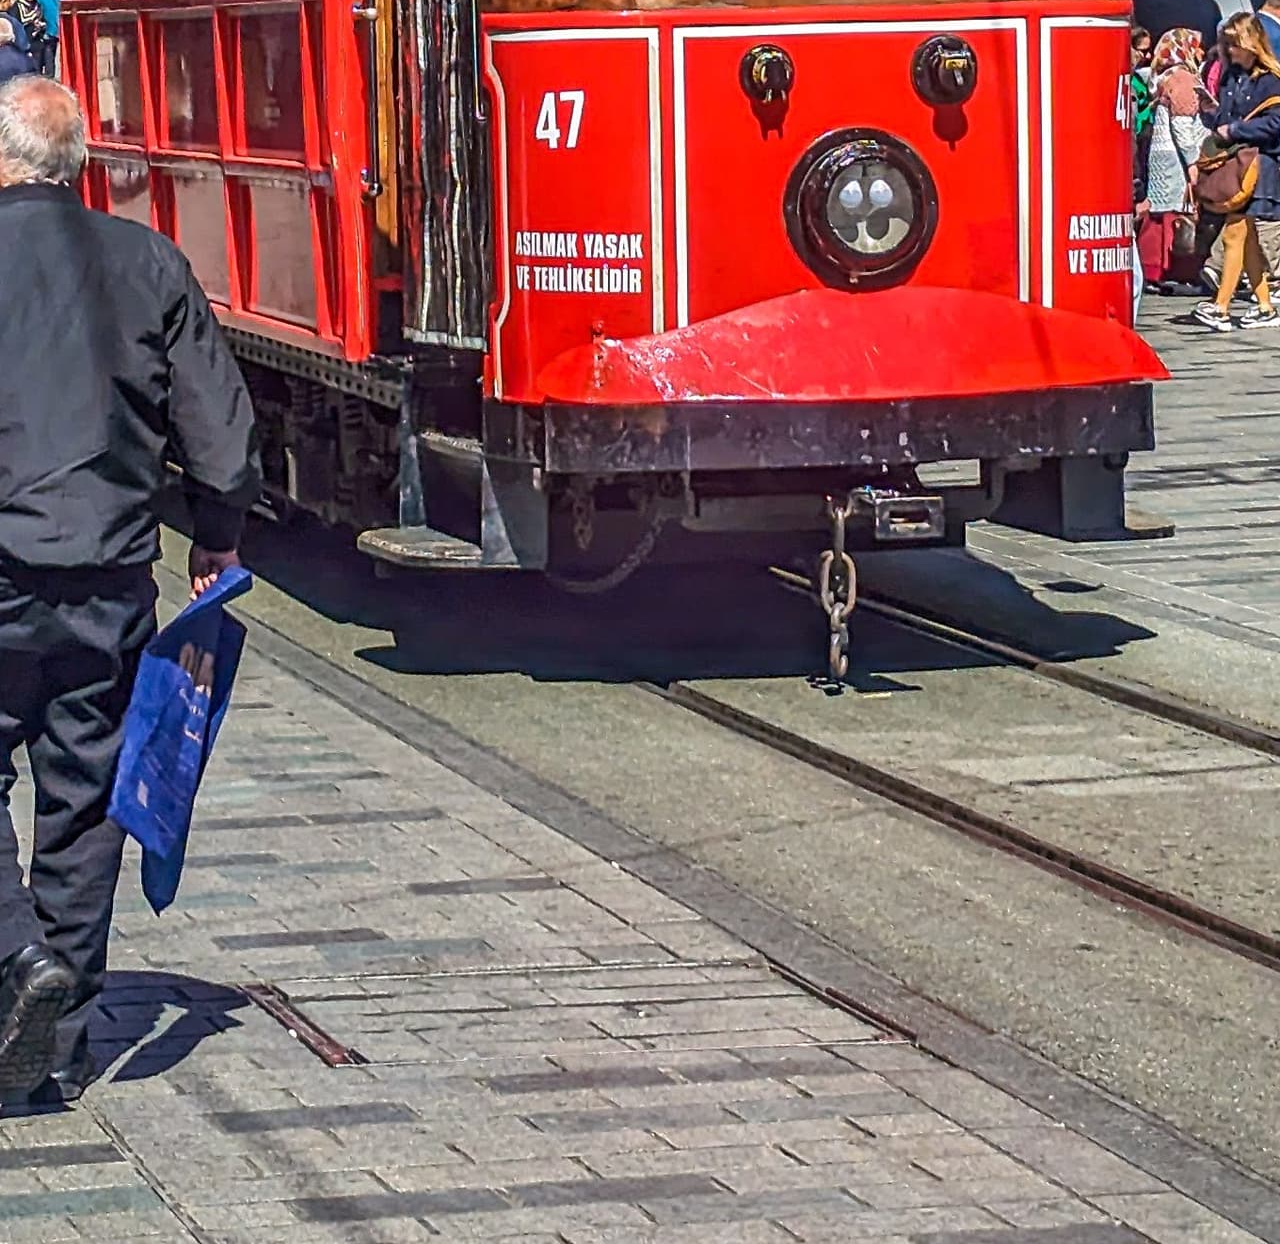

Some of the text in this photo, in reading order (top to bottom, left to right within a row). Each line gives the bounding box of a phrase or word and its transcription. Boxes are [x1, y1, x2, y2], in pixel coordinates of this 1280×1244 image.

[535, 90, 585, 149] 47
[1069, 214, 1123, 240] ASILMAK
[516, 231, 644, 259] ASILMAK YASAK
[1068, 249, 1087, 274] VE
[516, 263, 643, 293] VE TEHLİKELİDİR
